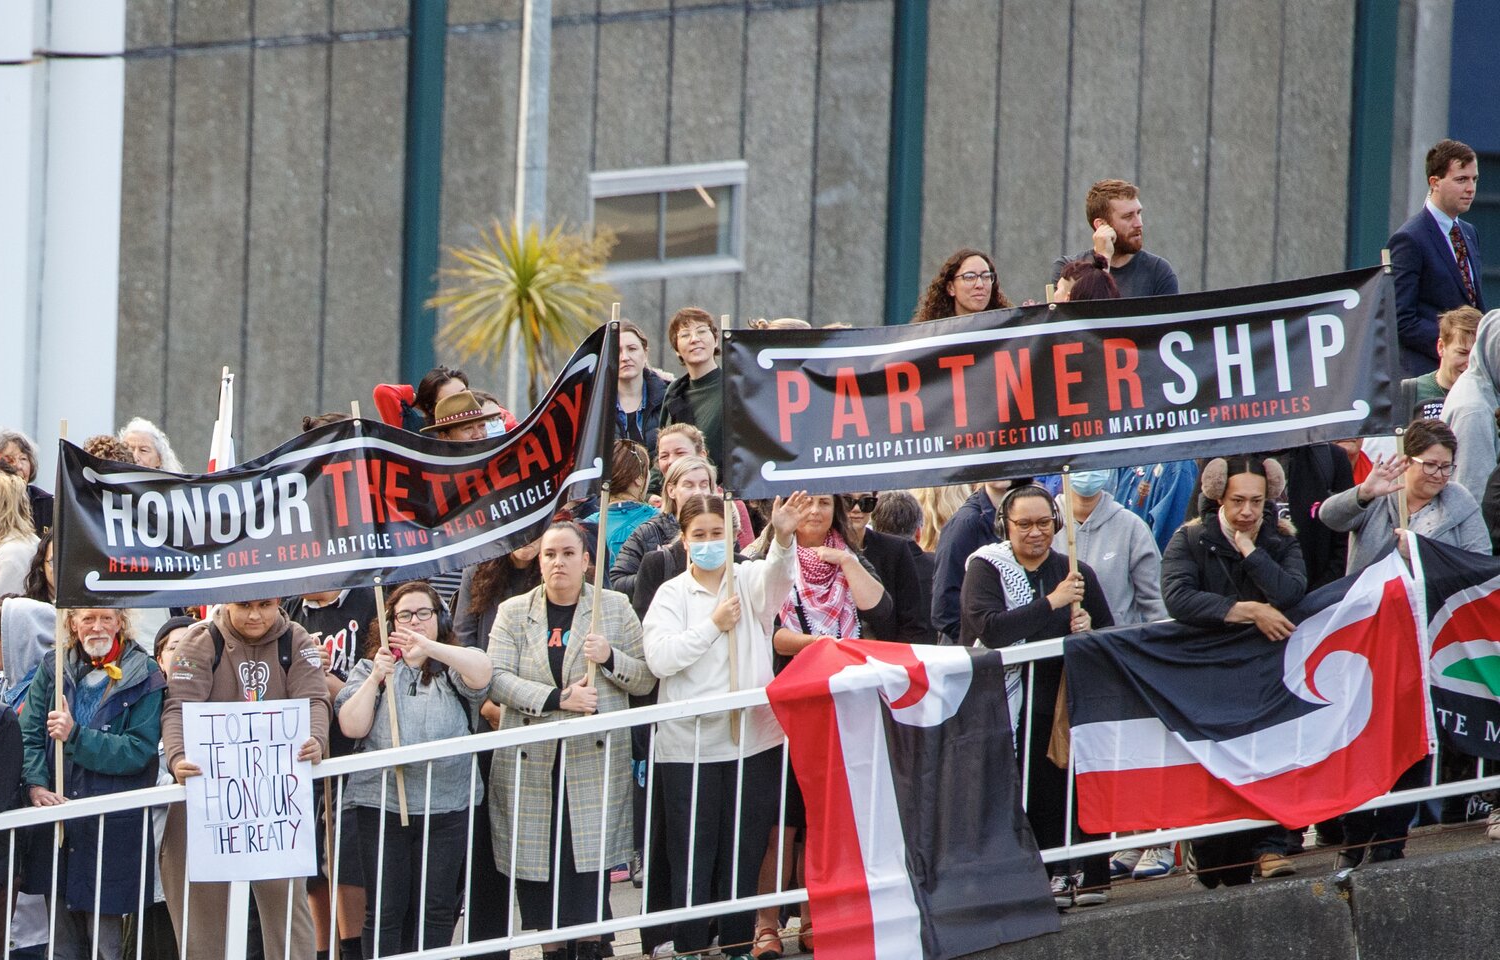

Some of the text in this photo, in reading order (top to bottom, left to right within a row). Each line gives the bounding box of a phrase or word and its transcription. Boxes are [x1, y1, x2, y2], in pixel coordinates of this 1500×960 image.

[775, 313, 1346, 443] PARTNERSHIP
[102, 472, 312, 548] HONOUR
[322, 459, 417, 528] THE
[421, 382, 584, 517] TREATY
[108, 556, 149, 573] READ
[154, 553, 222, 572] ARTICLE
[228, 548, 260, 568] ONE
[278, 541, 322, 562] READ
[327, 532, 392, 556] ARTICLE
[394, 528, 428, 550] TWO
[444, 512, 486, 538] READ
[490, 479, 552, 521] ARTICLE
[1436, 708, 1468, 736] TE
[200, 741, 294, 779] TE TIRITI
[204, 773, 302, 820] HONOUR
[204, 819, 301, 854] THE TREATY
